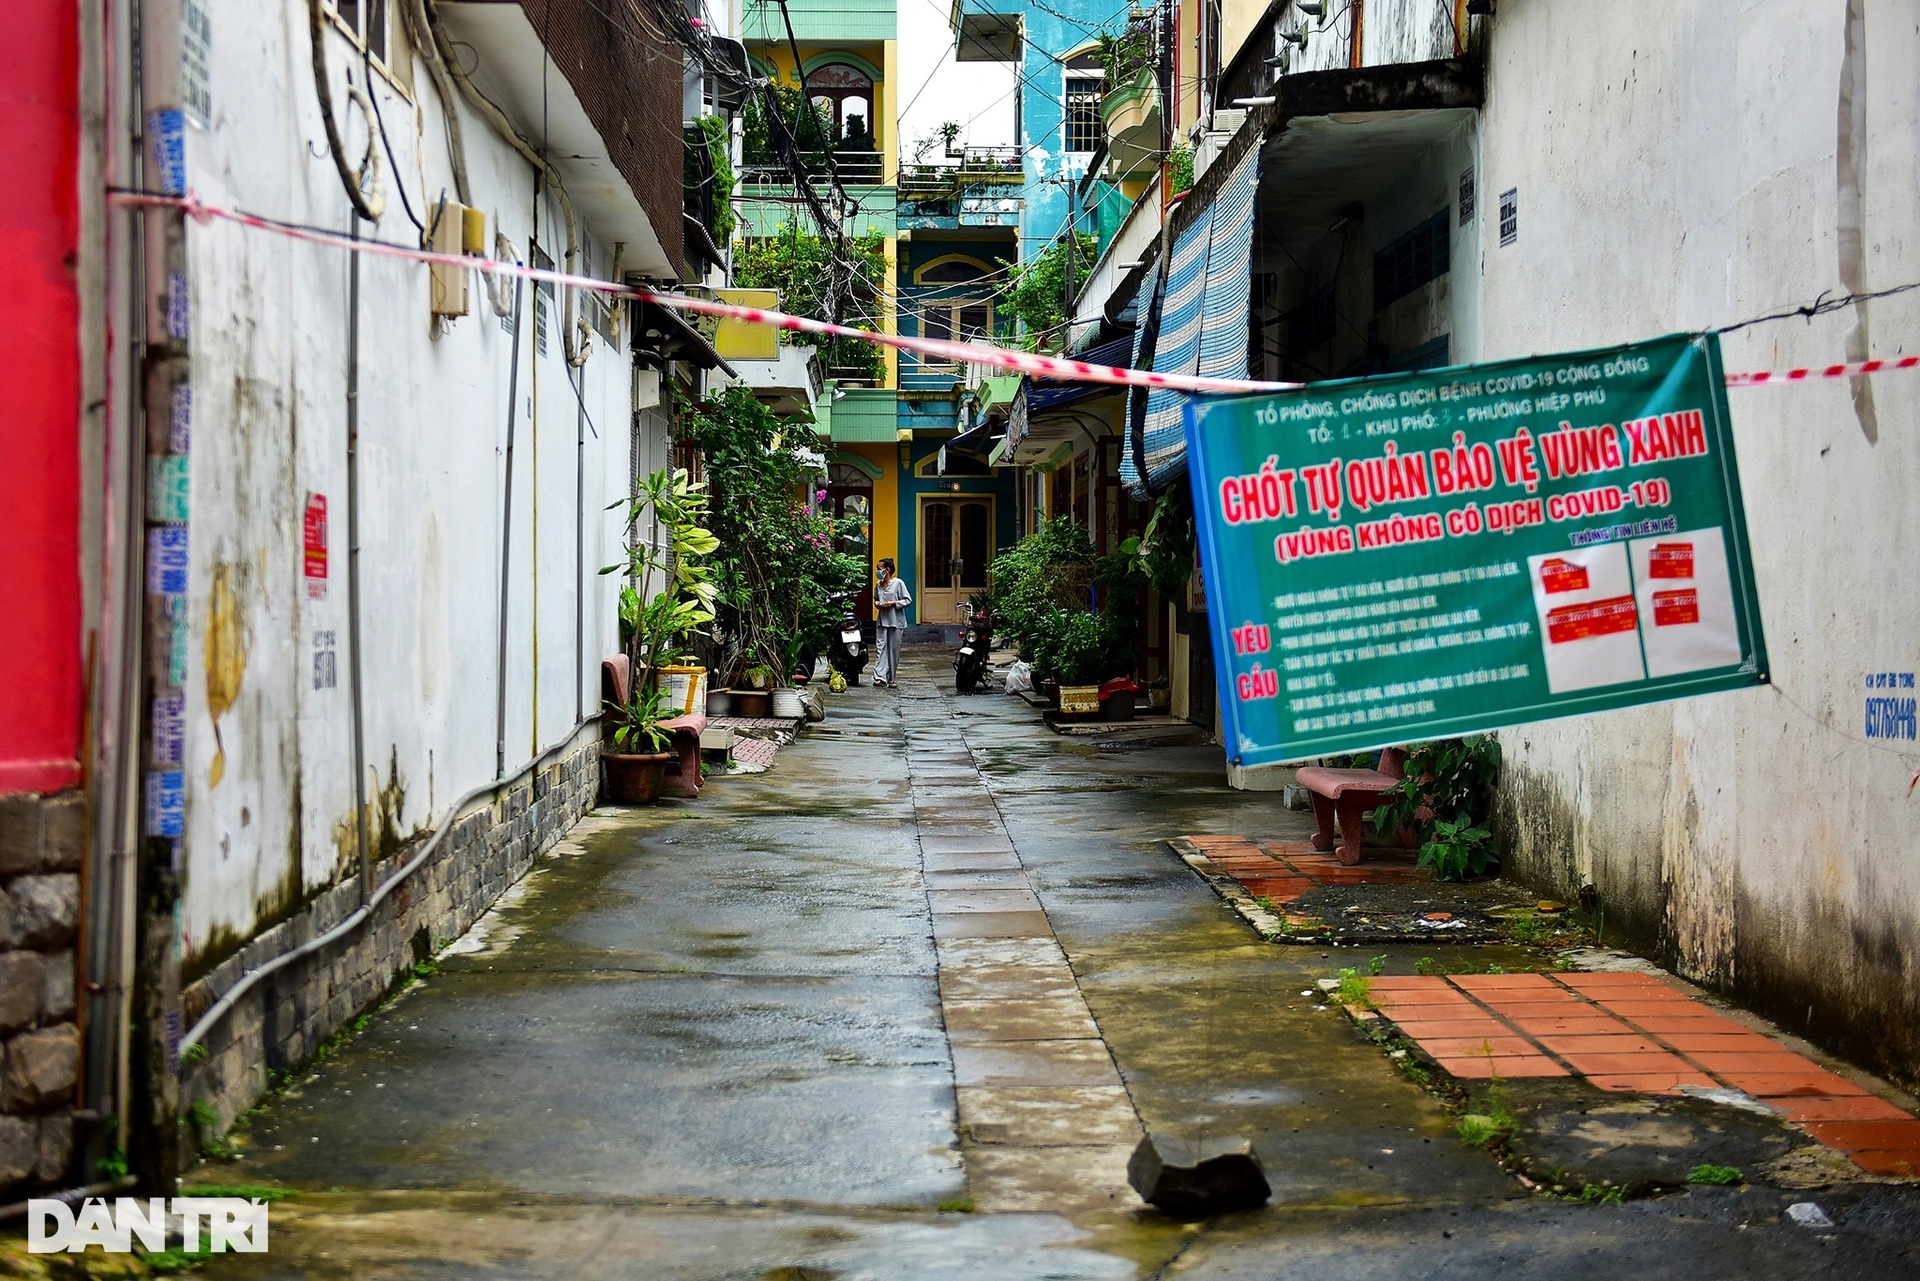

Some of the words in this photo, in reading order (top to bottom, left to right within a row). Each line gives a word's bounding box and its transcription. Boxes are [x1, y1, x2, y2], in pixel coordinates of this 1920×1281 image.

[1255, 401, 1278, 426] TỔ
[1341, 389, 1397, 416] CHỐNG
[1400, 386, 1437, 409] DỊCH
[1439, 378, 1482, 402] BỆNH
[1485, 371, 1554, 395] COVID-19
[1556, 363, 1601, 386] CỘNG
[1604, 356, 1650, 378] ĐỒNG
[1365, 418, 1399, 437] KHU
[1467, 398, 1533, 423] PHƯỜNG
[1535, 390, 1570, 413] HIỆP
[1574, 386, 1606, 407] PHÚ
[1219, 454, 1297, 526] CHỐT
[1301, 457, 1343, 521] TỰ
[1345, 439, 1430, 514] QUẢN
[1430, 429, 1495, 496] BẢO
[1497, 425, 1540, 493] VỆ
[1540, 420, 1624, 480] VÙNG
[1621, 408, 1708, 467] XANH
[1274, 524, 1353, 565] (VÙNG
[1355, 512, 1443, 550] KHÔNG
[1447, 502, 1482, 537] CÓ
[1485, 499, 1543, 535] DỊCH
[1547, 478, 1671, 521] COVID-19)
[1661, 514, 1677, 535] HỆ
[1230, 621, 1271, 655] YÊU
[1236, 662, 1280, 701] CẦU
